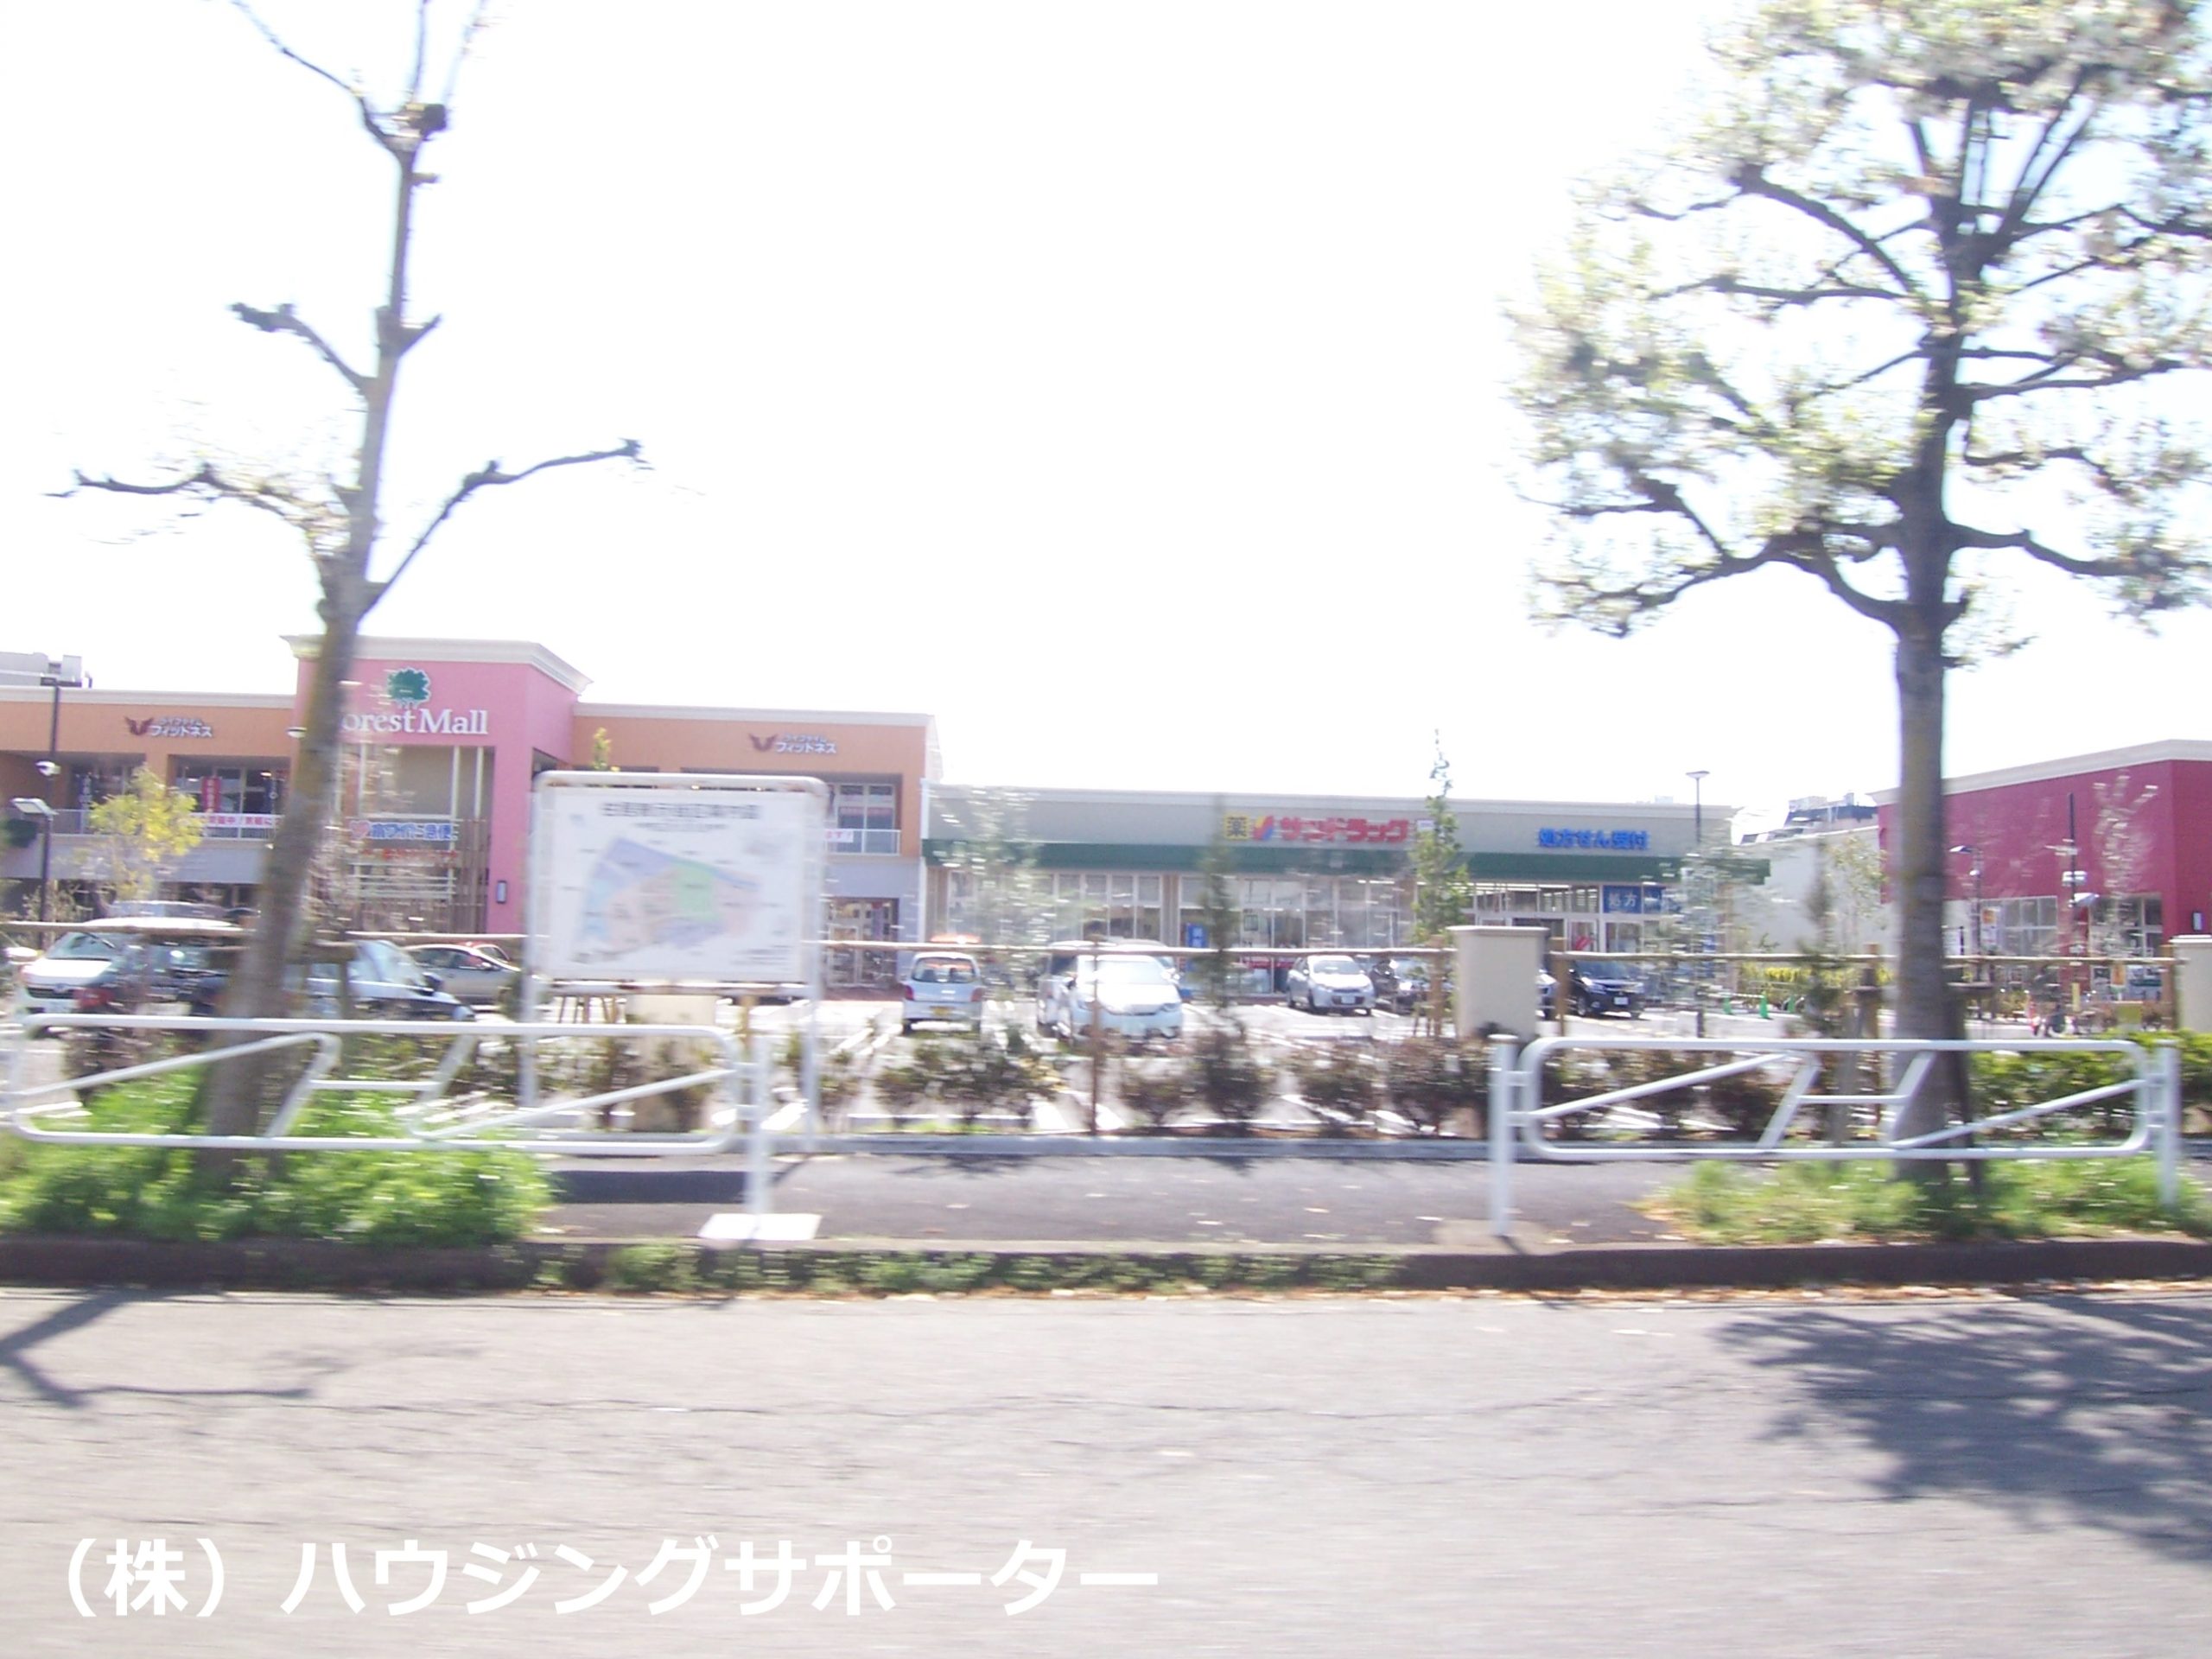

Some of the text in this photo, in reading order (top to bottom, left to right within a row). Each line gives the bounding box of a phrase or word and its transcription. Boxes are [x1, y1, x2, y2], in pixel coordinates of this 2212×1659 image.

[340, 709, 488, 734] orest Mall
[775, 741, 837, 754] フィットネス
[1538, 827, 1649, 850] 処方せん受付
